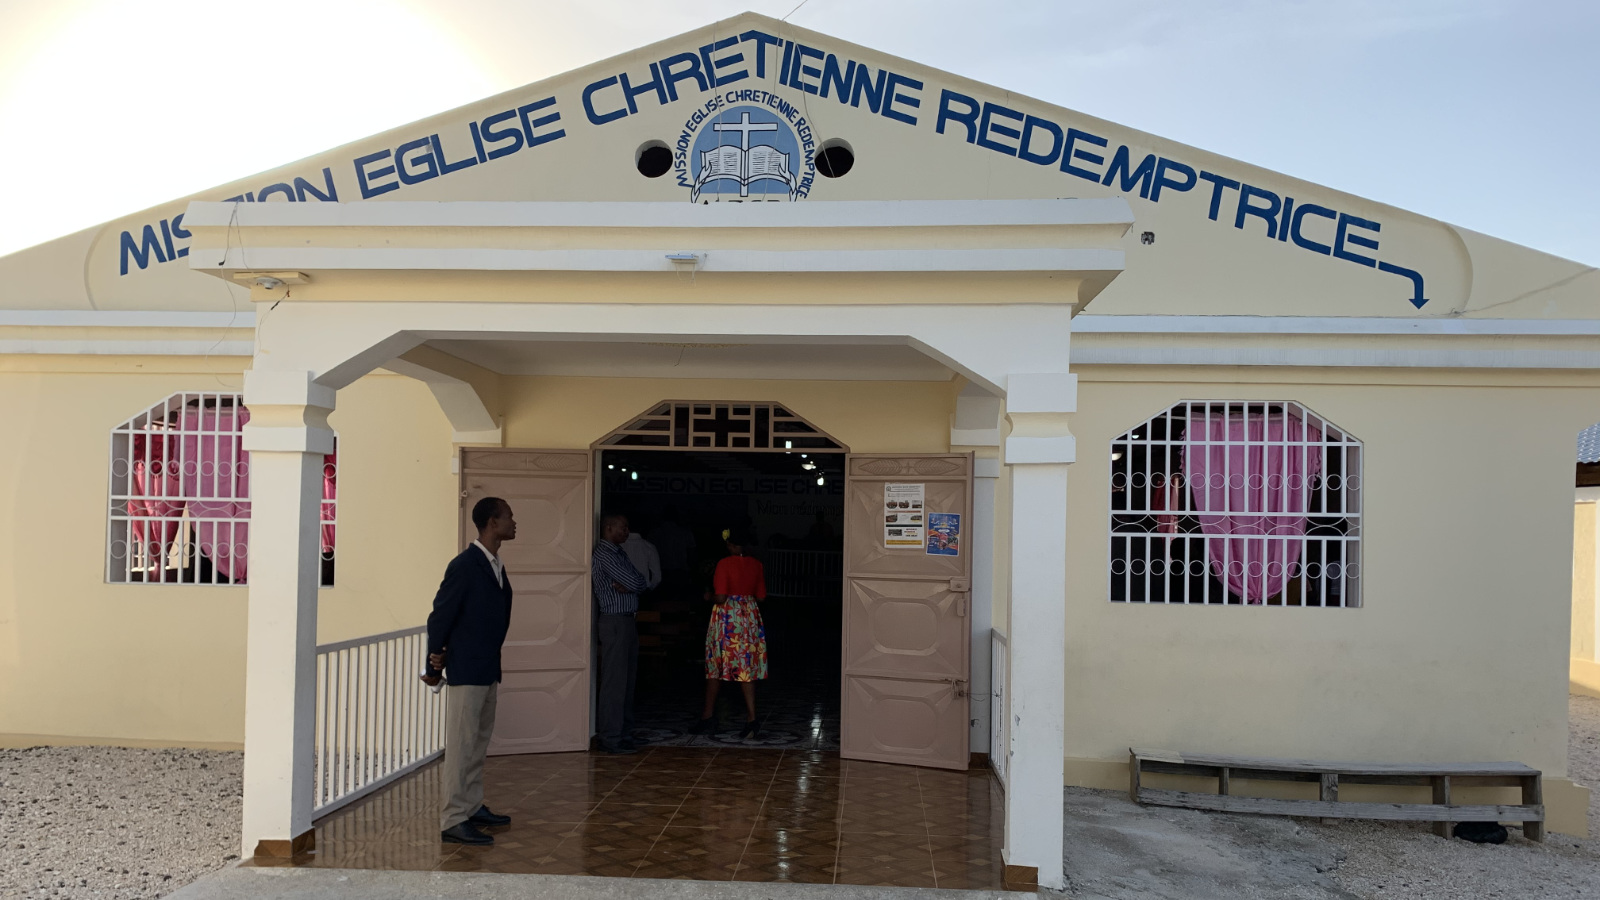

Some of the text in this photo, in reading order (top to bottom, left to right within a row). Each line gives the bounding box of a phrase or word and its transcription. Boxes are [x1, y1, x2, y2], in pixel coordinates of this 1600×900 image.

[119, 30, 1381, 277] MISN EGLISE CHRETIENNE REDEMPTRICE
[674, 89, 816, 200] MISSION EGLISE CHRETIENNE REDEMPTRICE
[605, 477, 705, 493] MISSION
[709, 478, 787, 495] EGLISE
